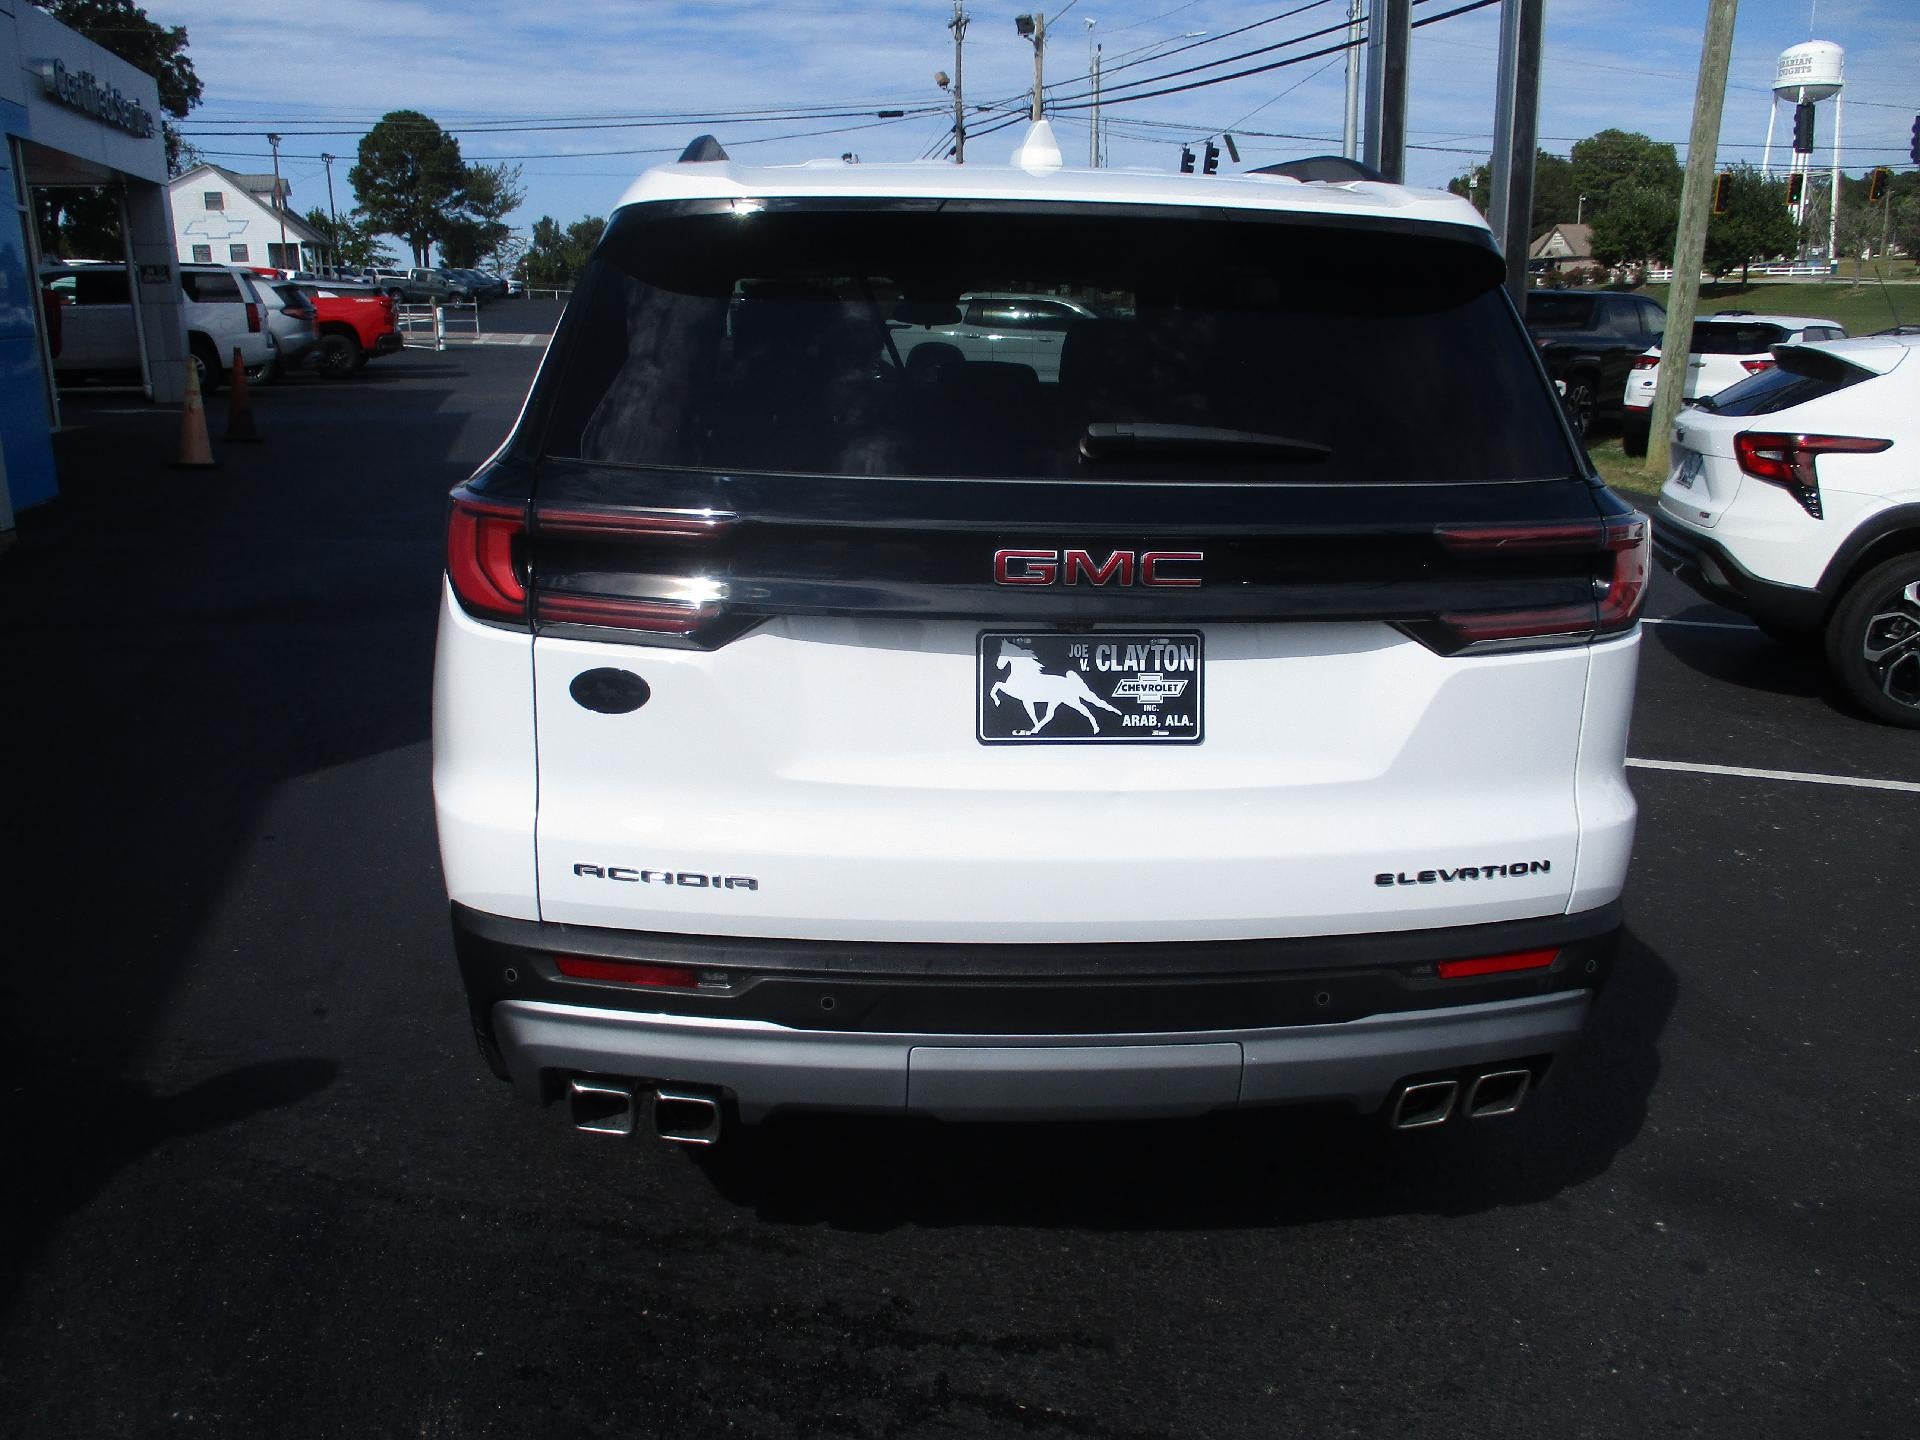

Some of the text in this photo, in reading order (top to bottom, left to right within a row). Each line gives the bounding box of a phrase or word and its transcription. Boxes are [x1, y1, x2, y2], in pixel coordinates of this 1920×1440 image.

[994, 549, 1203, 587] GMC
[1069, 644, 1195, 672] JOE V. CLAYTON
[1121, 683, 1179, 692] CHEVROLET
[1121, 714, 1194, 728] ARAB, ALA.
[1143, 704, 1160, 712] INC.
[573, 862, 759, 891] ACADIA
[1374, 860, 1551, 887] ELEVATION
